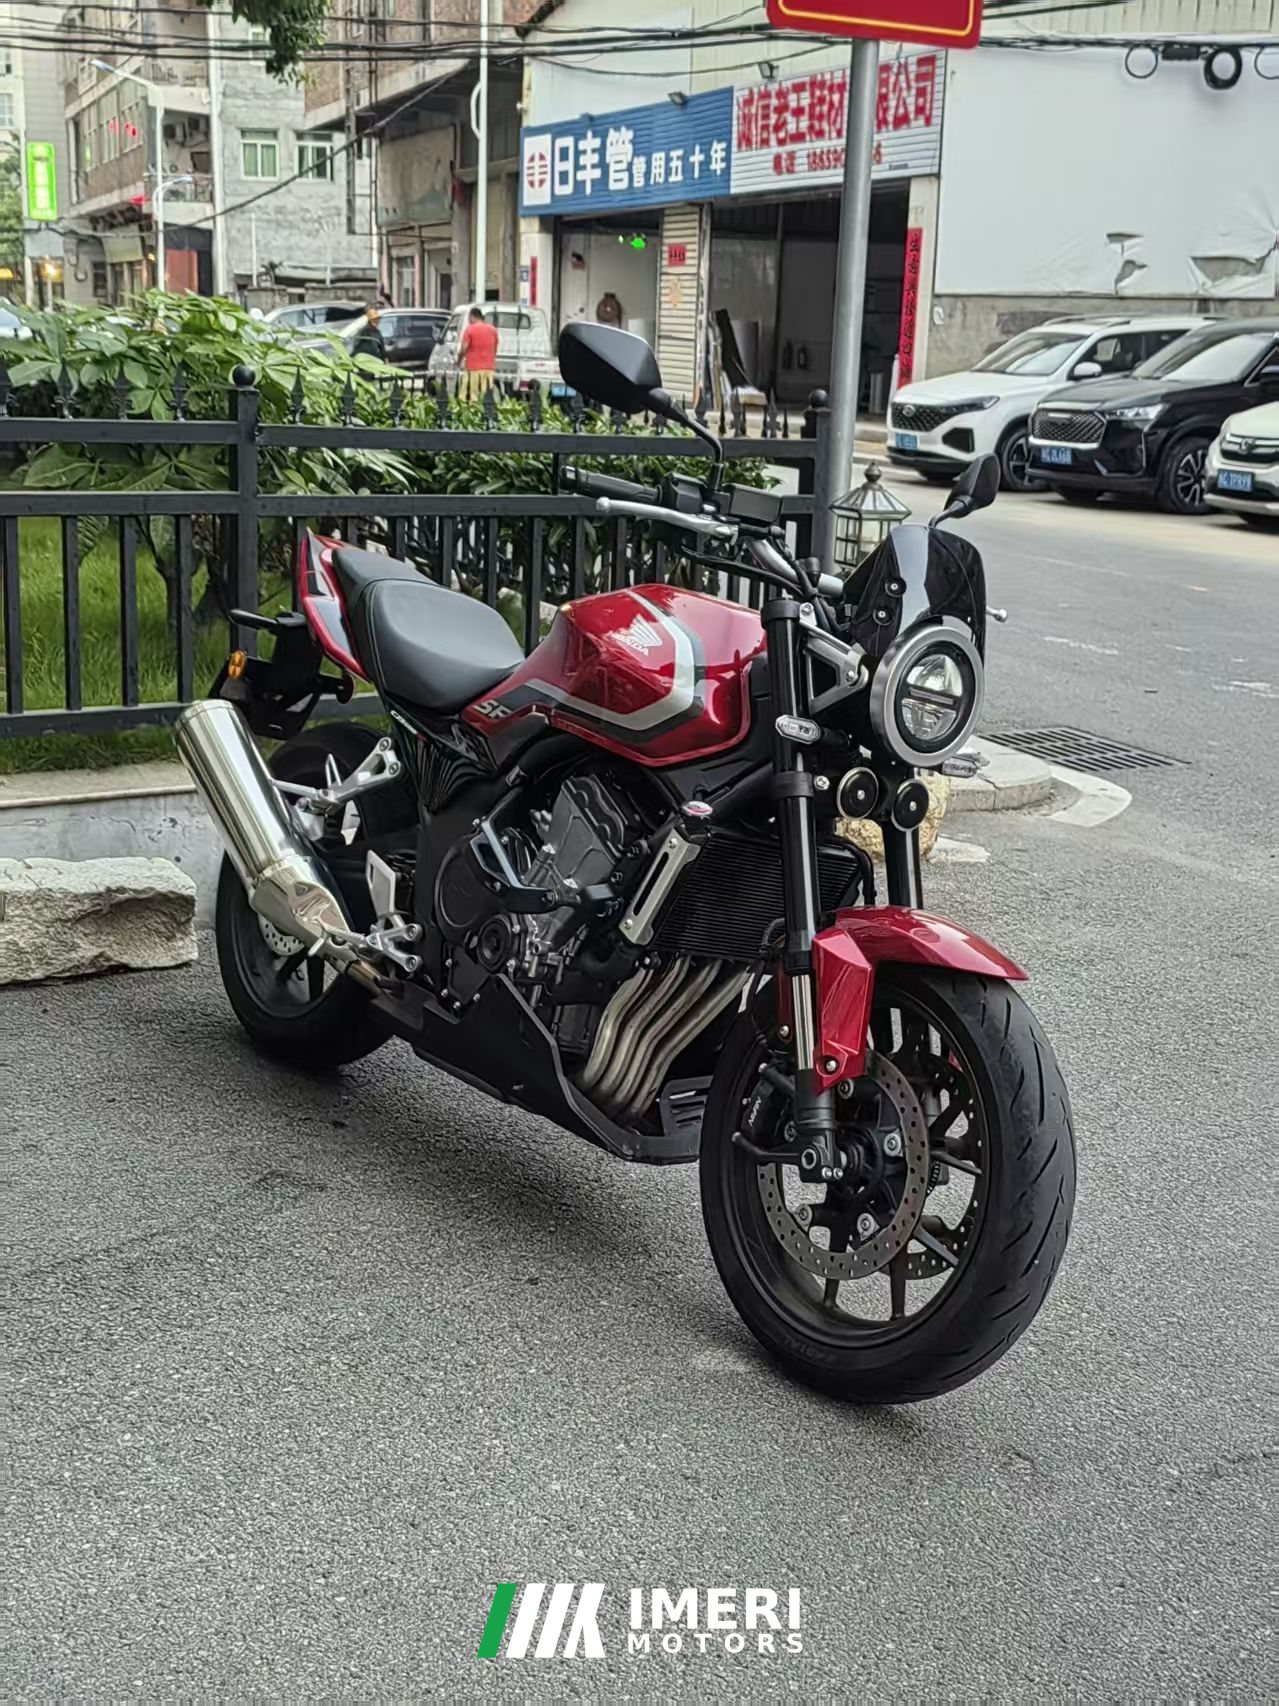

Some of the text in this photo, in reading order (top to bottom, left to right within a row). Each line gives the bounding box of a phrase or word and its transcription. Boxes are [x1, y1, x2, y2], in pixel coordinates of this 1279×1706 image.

[736, 54, 937, 149] 诚信老王鞋材限公司
[553, 126, 728, 196] 日丰管 管用五十年
[471, 699, 512, 719] SF
